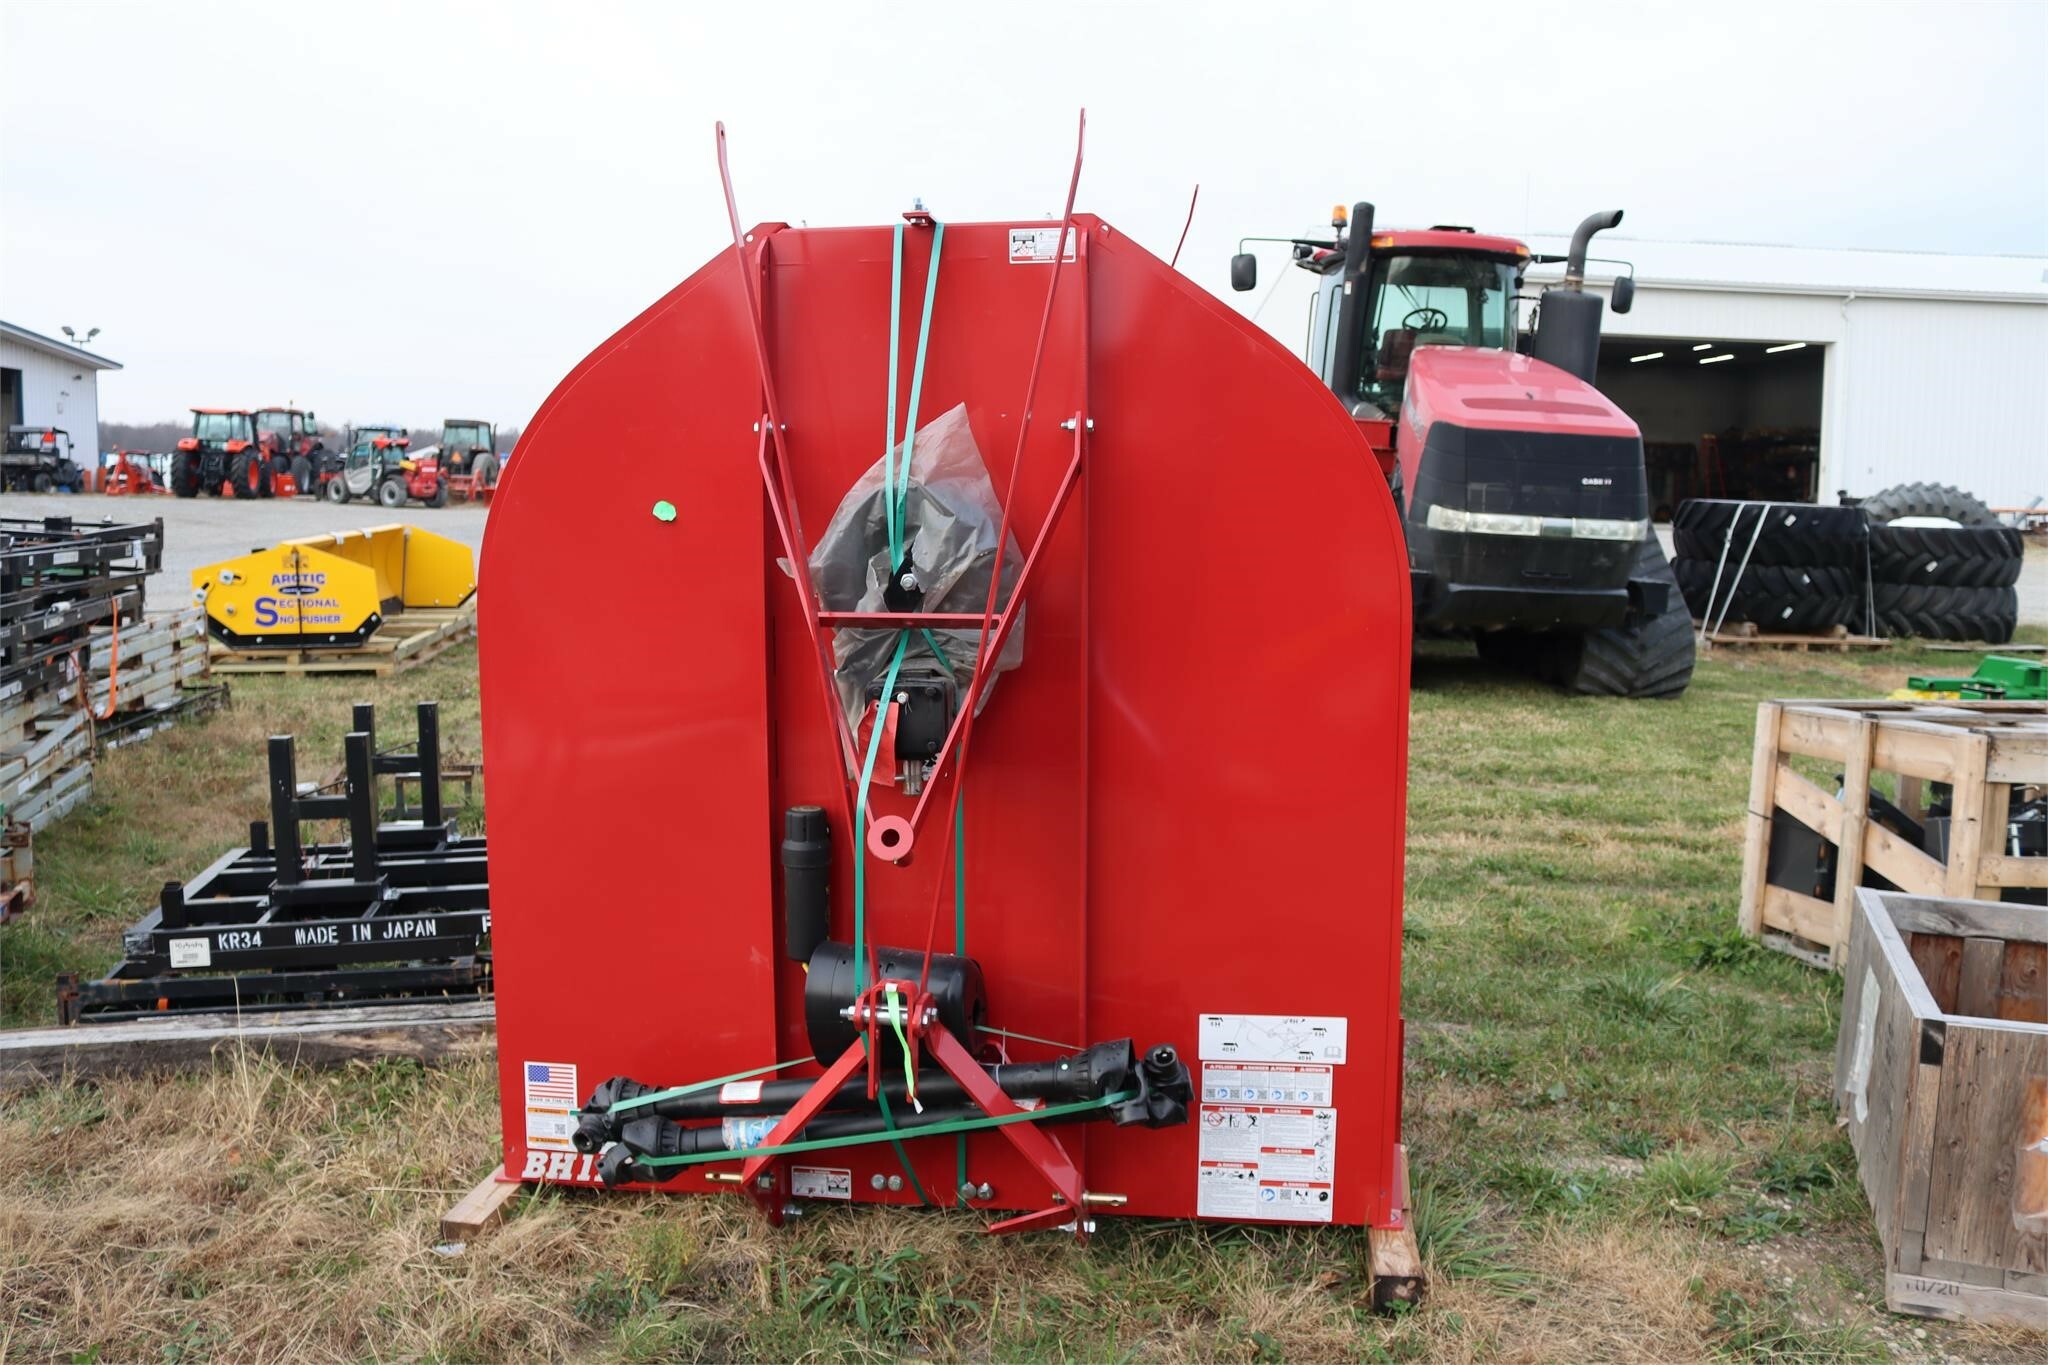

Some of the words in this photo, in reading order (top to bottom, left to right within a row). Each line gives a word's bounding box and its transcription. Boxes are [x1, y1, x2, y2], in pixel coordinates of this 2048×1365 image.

[218, 930, 262, 950] KR34
[294, 925, 339, 946] MADE
[352, 922, 372, 942] IN
[383, 918, 437, 940] JAPAN
